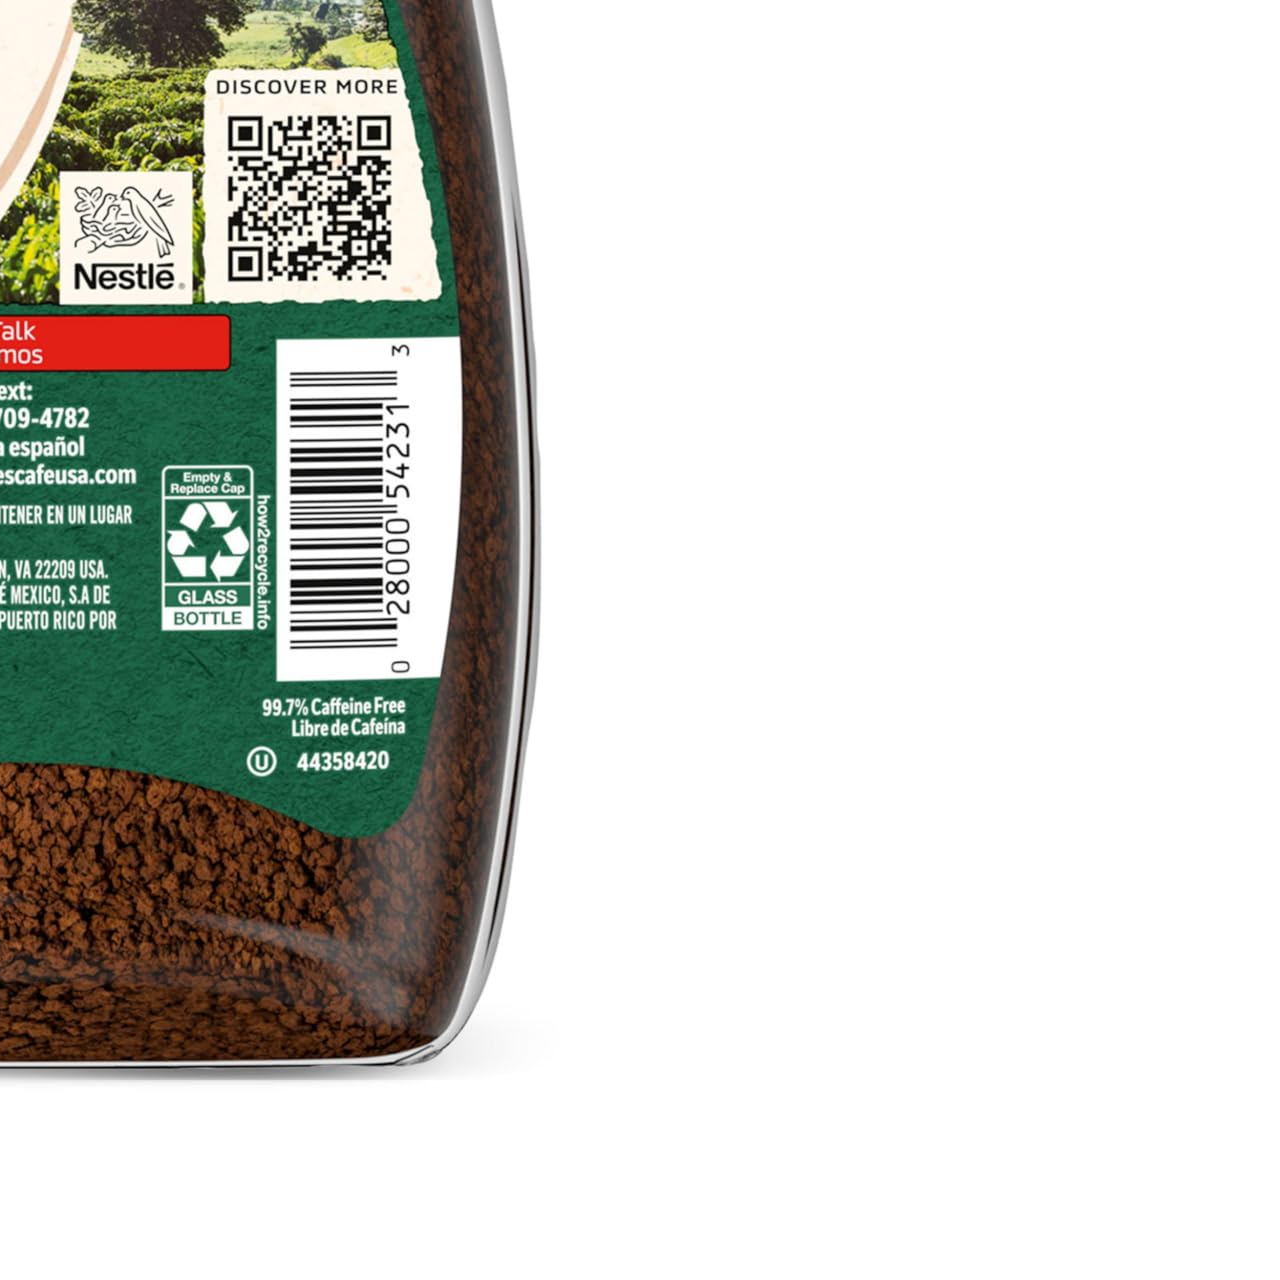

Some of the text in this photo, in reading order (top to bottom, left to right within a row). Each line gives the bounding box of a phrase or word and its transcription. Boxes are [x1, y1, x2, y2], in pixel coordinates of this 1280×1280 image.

[216, 79, 398, 95] DISCOVER MORE
[74, 262, 175, 290] Nestlé
[9, 435, 84, 461] español
[386, 405, 410, 498] 54231
[184, 472, 231, 484] Empty &
[171, 483, 245, 495] Replace Cap
[47, 505, 64, 524] EN
[68, 505, 86, 524] UN
[90, 505, 132, 524] LUGAR
[14, 560, 31, 579] VA
[35, 560, 75, 579] 22209
[80, 560, 108, 579] USA.
[256, 495, 271, 630] how2recycle.info
[386, 518, 410, 615] 28000
[178, 589, 238, 605] GLASS
[174, 611, 241, 625] BOTTLE
[262, 696, 406, 716] 99.7% Caffeine Free
[292, 719, 329, 737] Libre
[331, 719, 349, 736] de
[297, 750, 389, 771] 44358420
